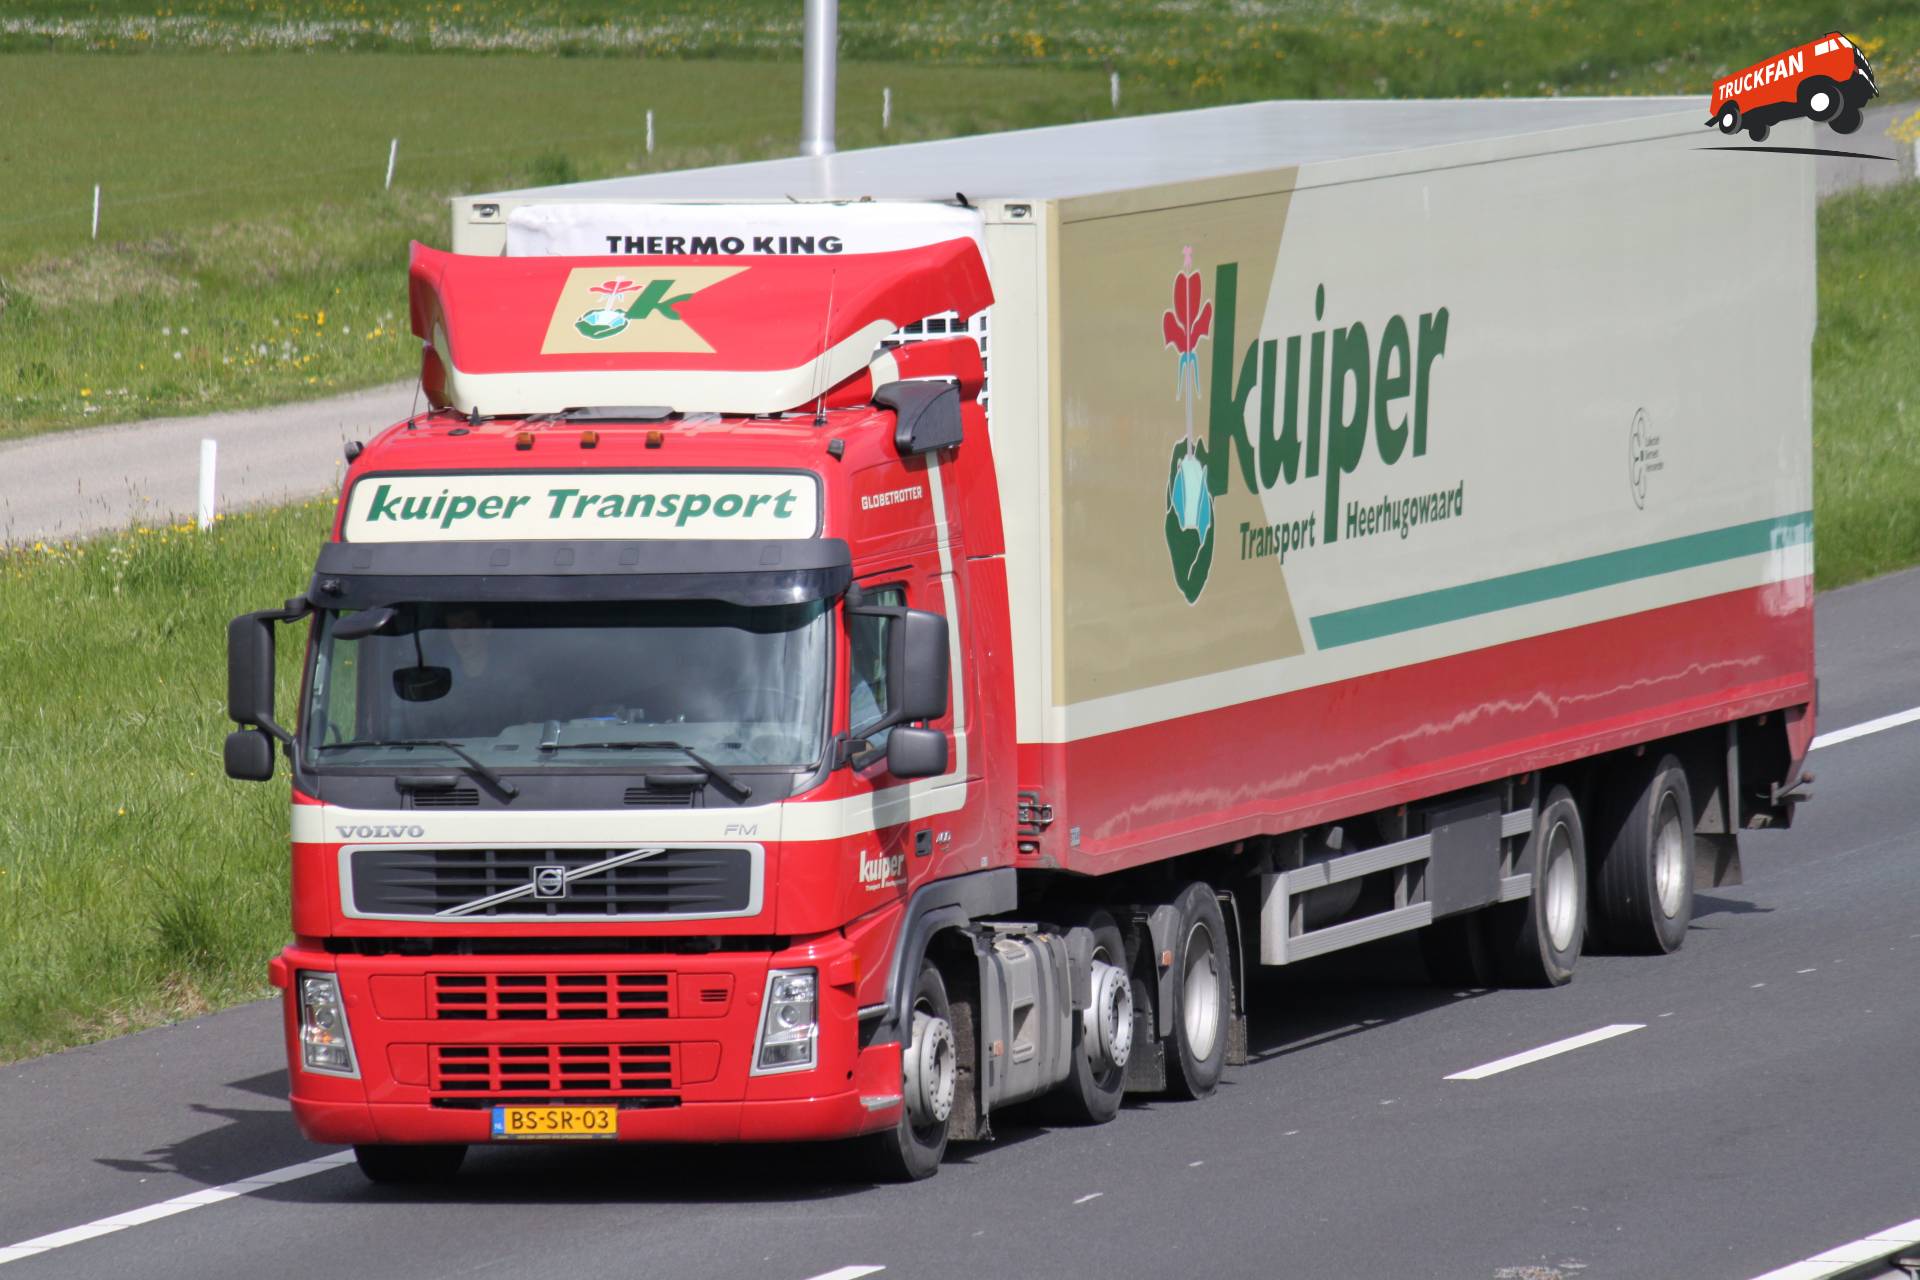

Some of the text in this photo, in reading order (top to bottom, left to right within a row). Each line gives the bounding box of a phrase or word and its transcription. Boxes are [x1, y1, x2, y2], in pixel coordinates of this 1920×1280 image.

[606, 236, 843, 254] THERMO KING
[1208, 262, 1449, 544] kuiper
[366, 484, 797, 529] kuiper Transport
[861, 485, 923, 510] GLOBETROTTER
[1240, 480, 1464, 565] Transport Heerhugowaard
[337, 825, 425, 838] VOLVO
[724, 825, 758, 836] FM
[859, 850, 904, 888] kuiper
[511, 1111, 609, 1129] BS-SR-03
